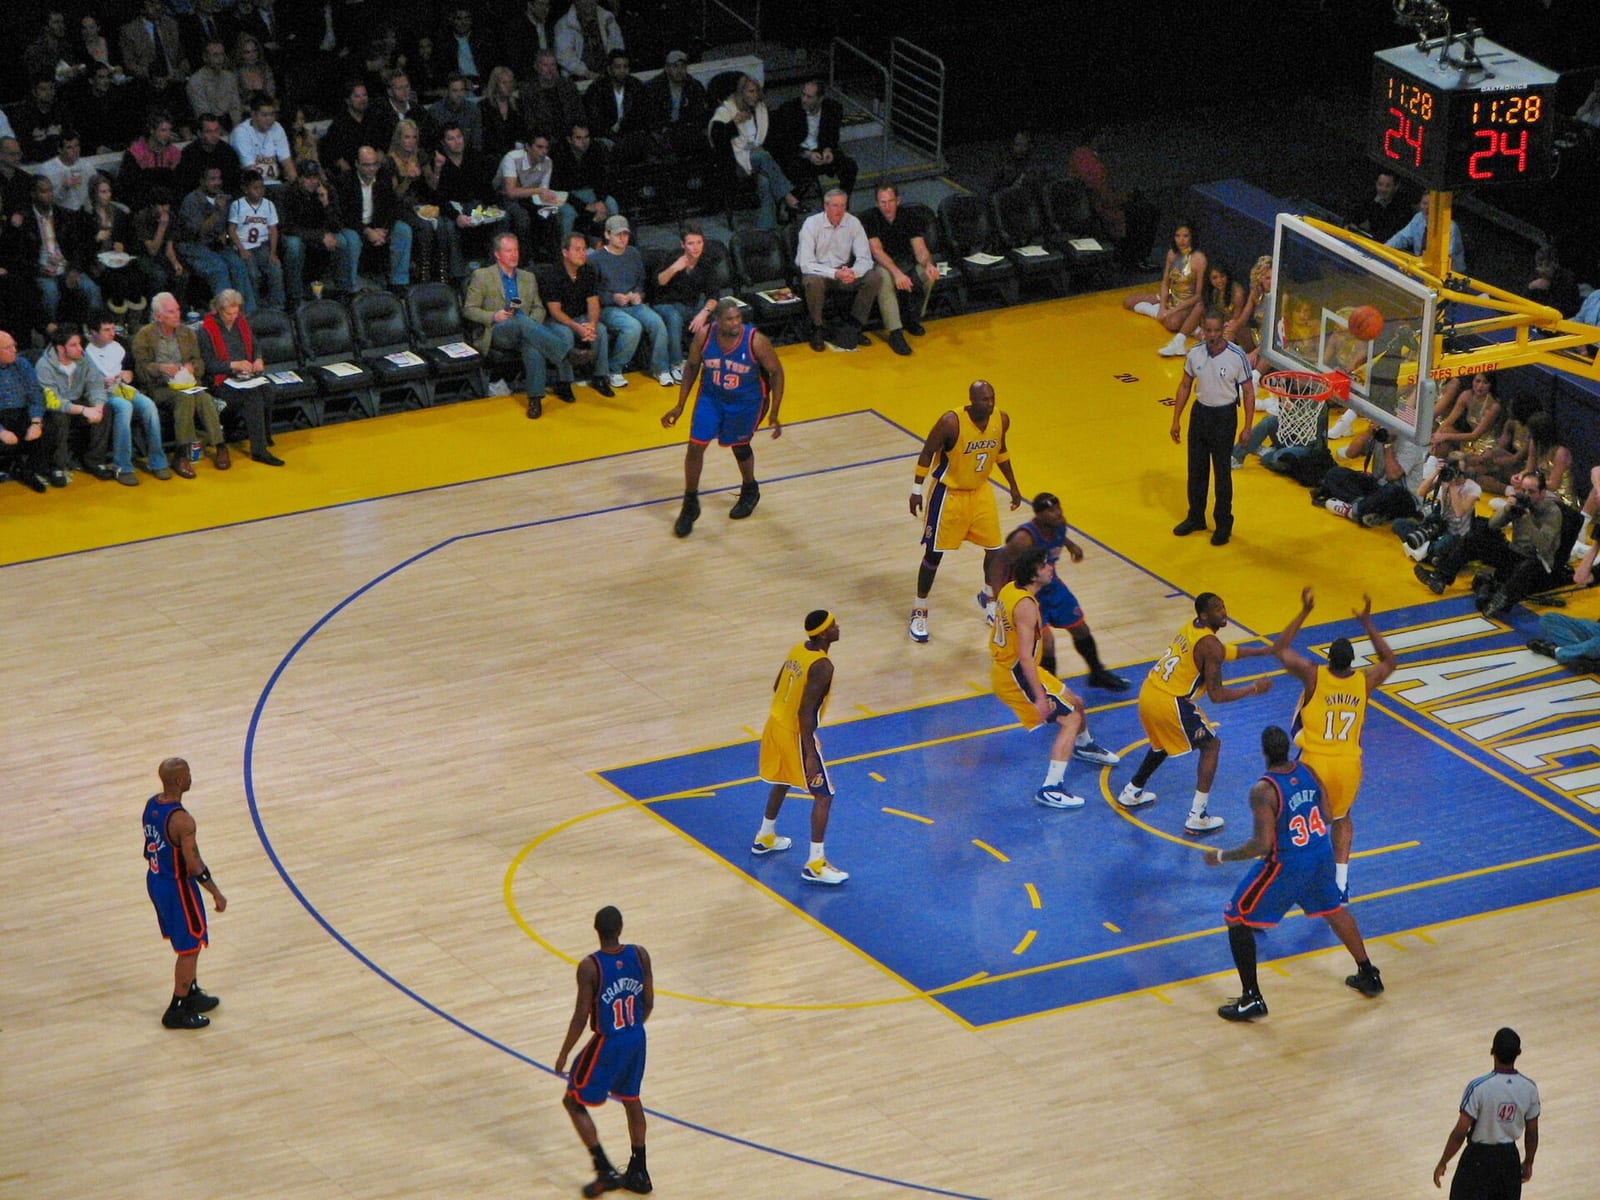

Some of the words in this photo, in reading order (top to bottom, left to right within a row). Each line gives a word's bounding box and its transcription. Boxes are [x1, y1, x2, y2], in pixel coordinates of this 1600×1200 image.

[1387, 77, 1433, 121] 11:28
[1472, 95, 1541, 124] 11:28
[1384, 107, 1424, 168] 24
[1468, 129, 1529, 179] 24
[248, 227, 260, 244] 8
[712, 370, 740, 390] 13
[1458, 361, 1499, 377] Center
[963, 439, 998, 455] LAKERS
[974, 452, 989, 473] 7
[1152, 647, 1181, 683] 24
[1322, 710, 1358, 741] 17
[1288, 805, 1327, 847] 34
[612, 994, 636, 1031] 11
[1497, 1104, 1515, 1121] 42
